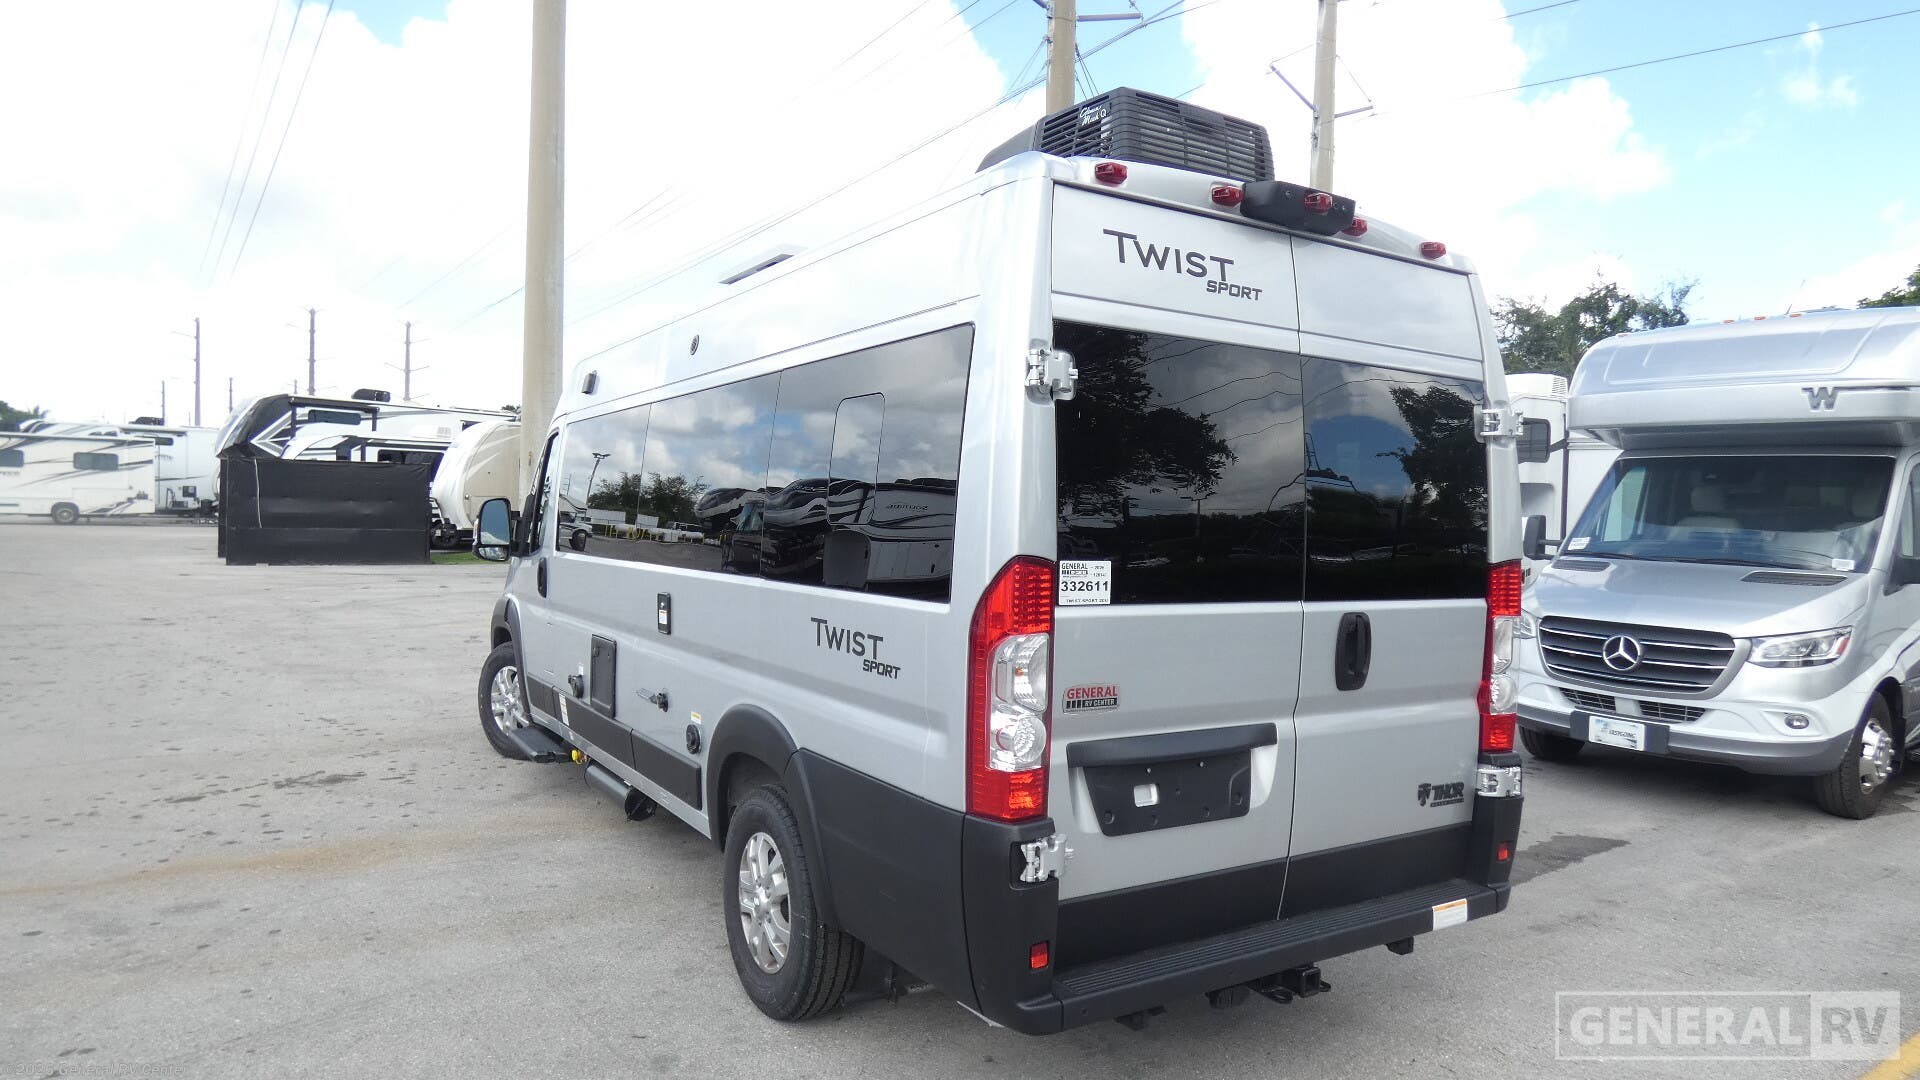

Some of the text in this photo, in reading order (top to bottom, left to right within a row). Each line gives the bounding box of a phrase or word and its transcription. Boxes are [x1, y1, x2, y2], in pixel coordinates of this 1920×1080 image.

[1206, 279, 1263, 301] SPORT
[1061, 562, 1089, 570] GENERAL
[1060, 580, 1109, 592] 332611
[862, 658, 902, 680] SPORT
[1067, 685, 1118, 699] GENERAL
[1093, 698, 1115, 706] CENTER
